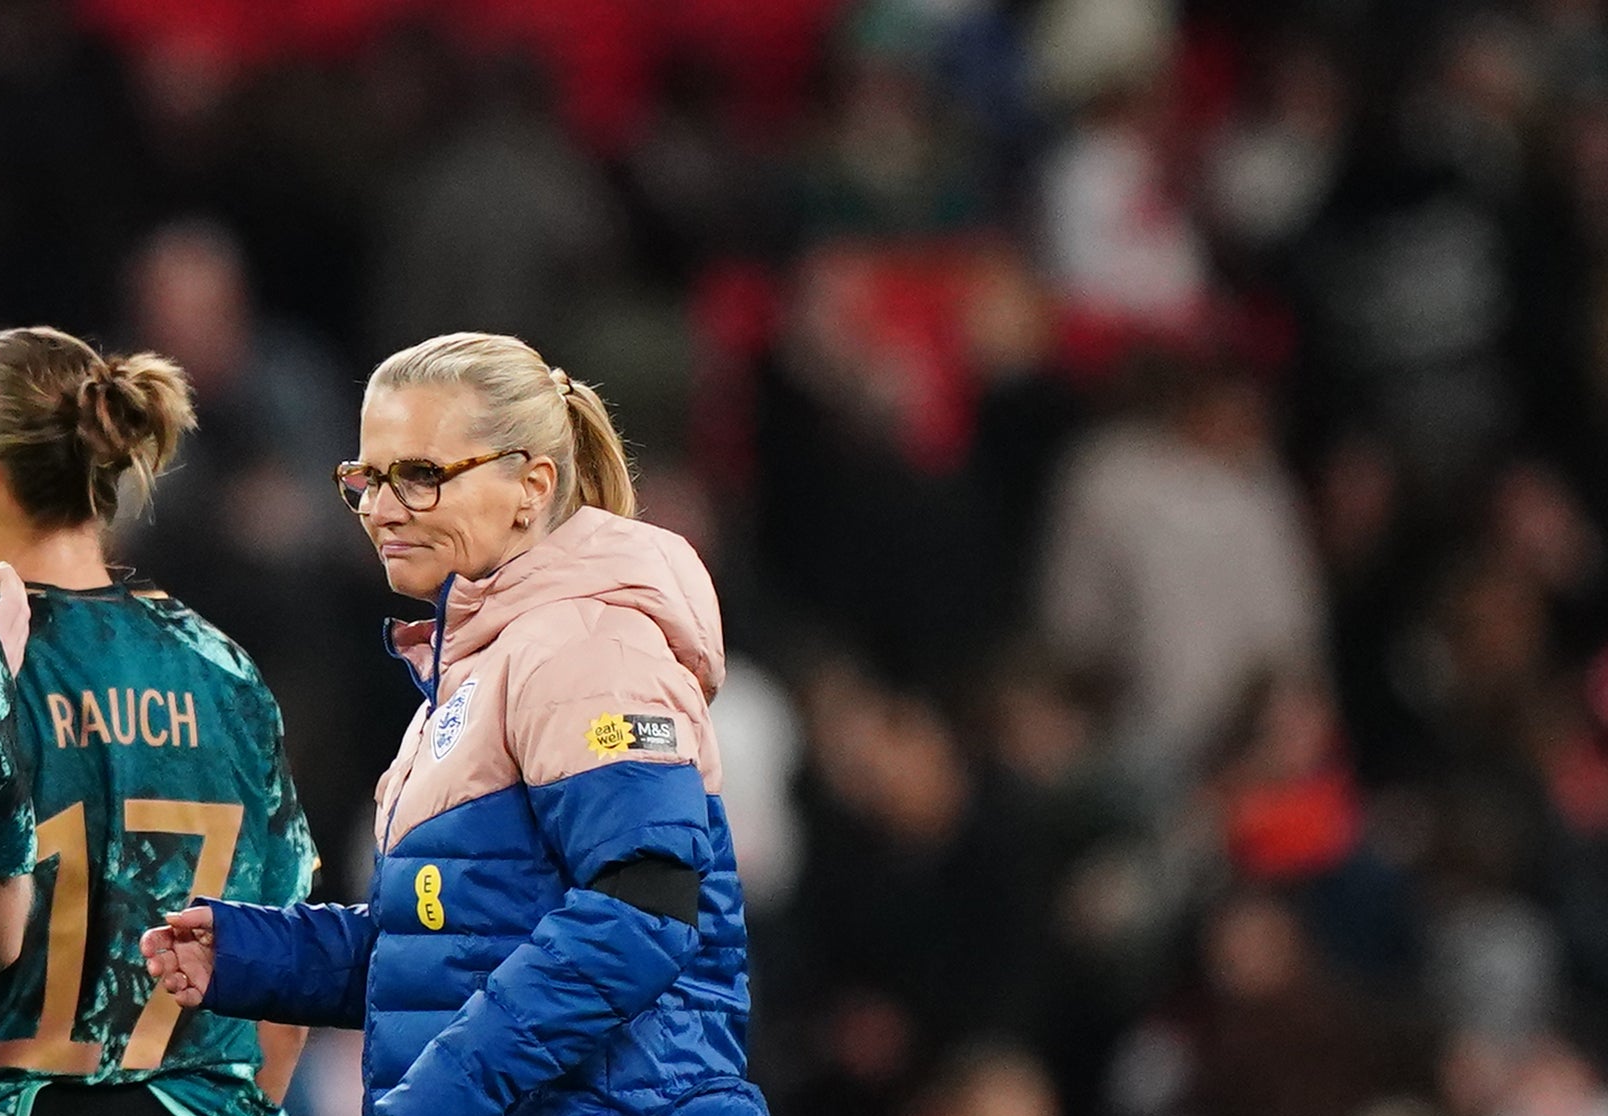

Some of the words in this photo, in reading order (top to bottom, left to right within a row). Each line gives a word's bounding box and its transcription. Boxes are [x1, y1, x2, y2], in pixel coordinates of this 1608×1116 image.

[47, 687, 199, 749] RAUCH
[594, 720, 617, 737] eat
[596, 728, 625, 746] well
[637, 722, 671, 738] M&S
